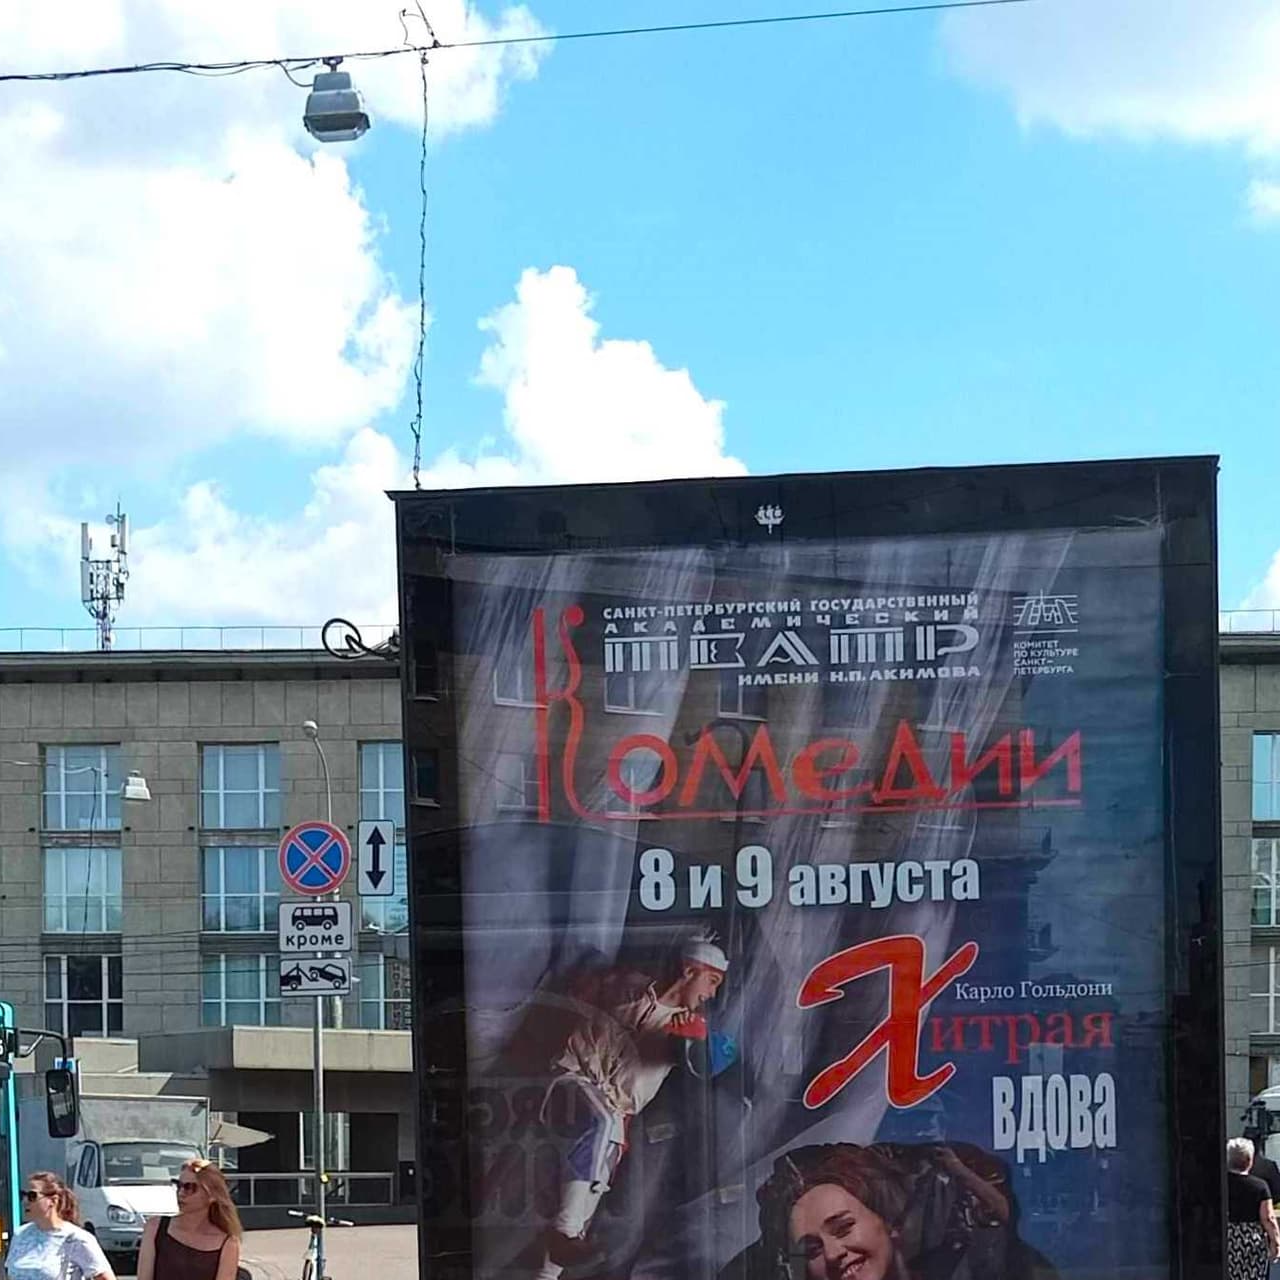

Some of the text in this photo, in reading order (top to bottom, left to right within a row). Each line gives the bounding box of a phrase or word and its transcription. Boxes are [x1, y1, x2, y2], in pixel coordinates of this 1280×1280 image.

[603, 591, 979, 620] САНКТ-ПЕТЕРБУРГСКИЙ ГОСУДАРСТВЕННЫЙ
[605, 606, 980, 633] АКАДЕМИЧЕСКИЙ
[604, 624, 980, 673] ТЕАТР
[1013, 640, 1059, 650] КОМИТЕТ
[1013, 648, 1080, 658] ПО КУЛЬТУРЕ
[738, 671, 819, 686] ИМЕНИ
[870, 664, 981, 680] АКИМОВА
[1013, 665, 1075, 675] ПЕТЕРБУРГА
[638, 845, 980, 911] 8 и 9 августа
[285, 932, 345, 949] кроме
[955, 980, 1113, 1003] Карло Гольдони
[796, 934, 1115, 1109] Хитрая
[992, 1072, 1117, 1164] вдова
